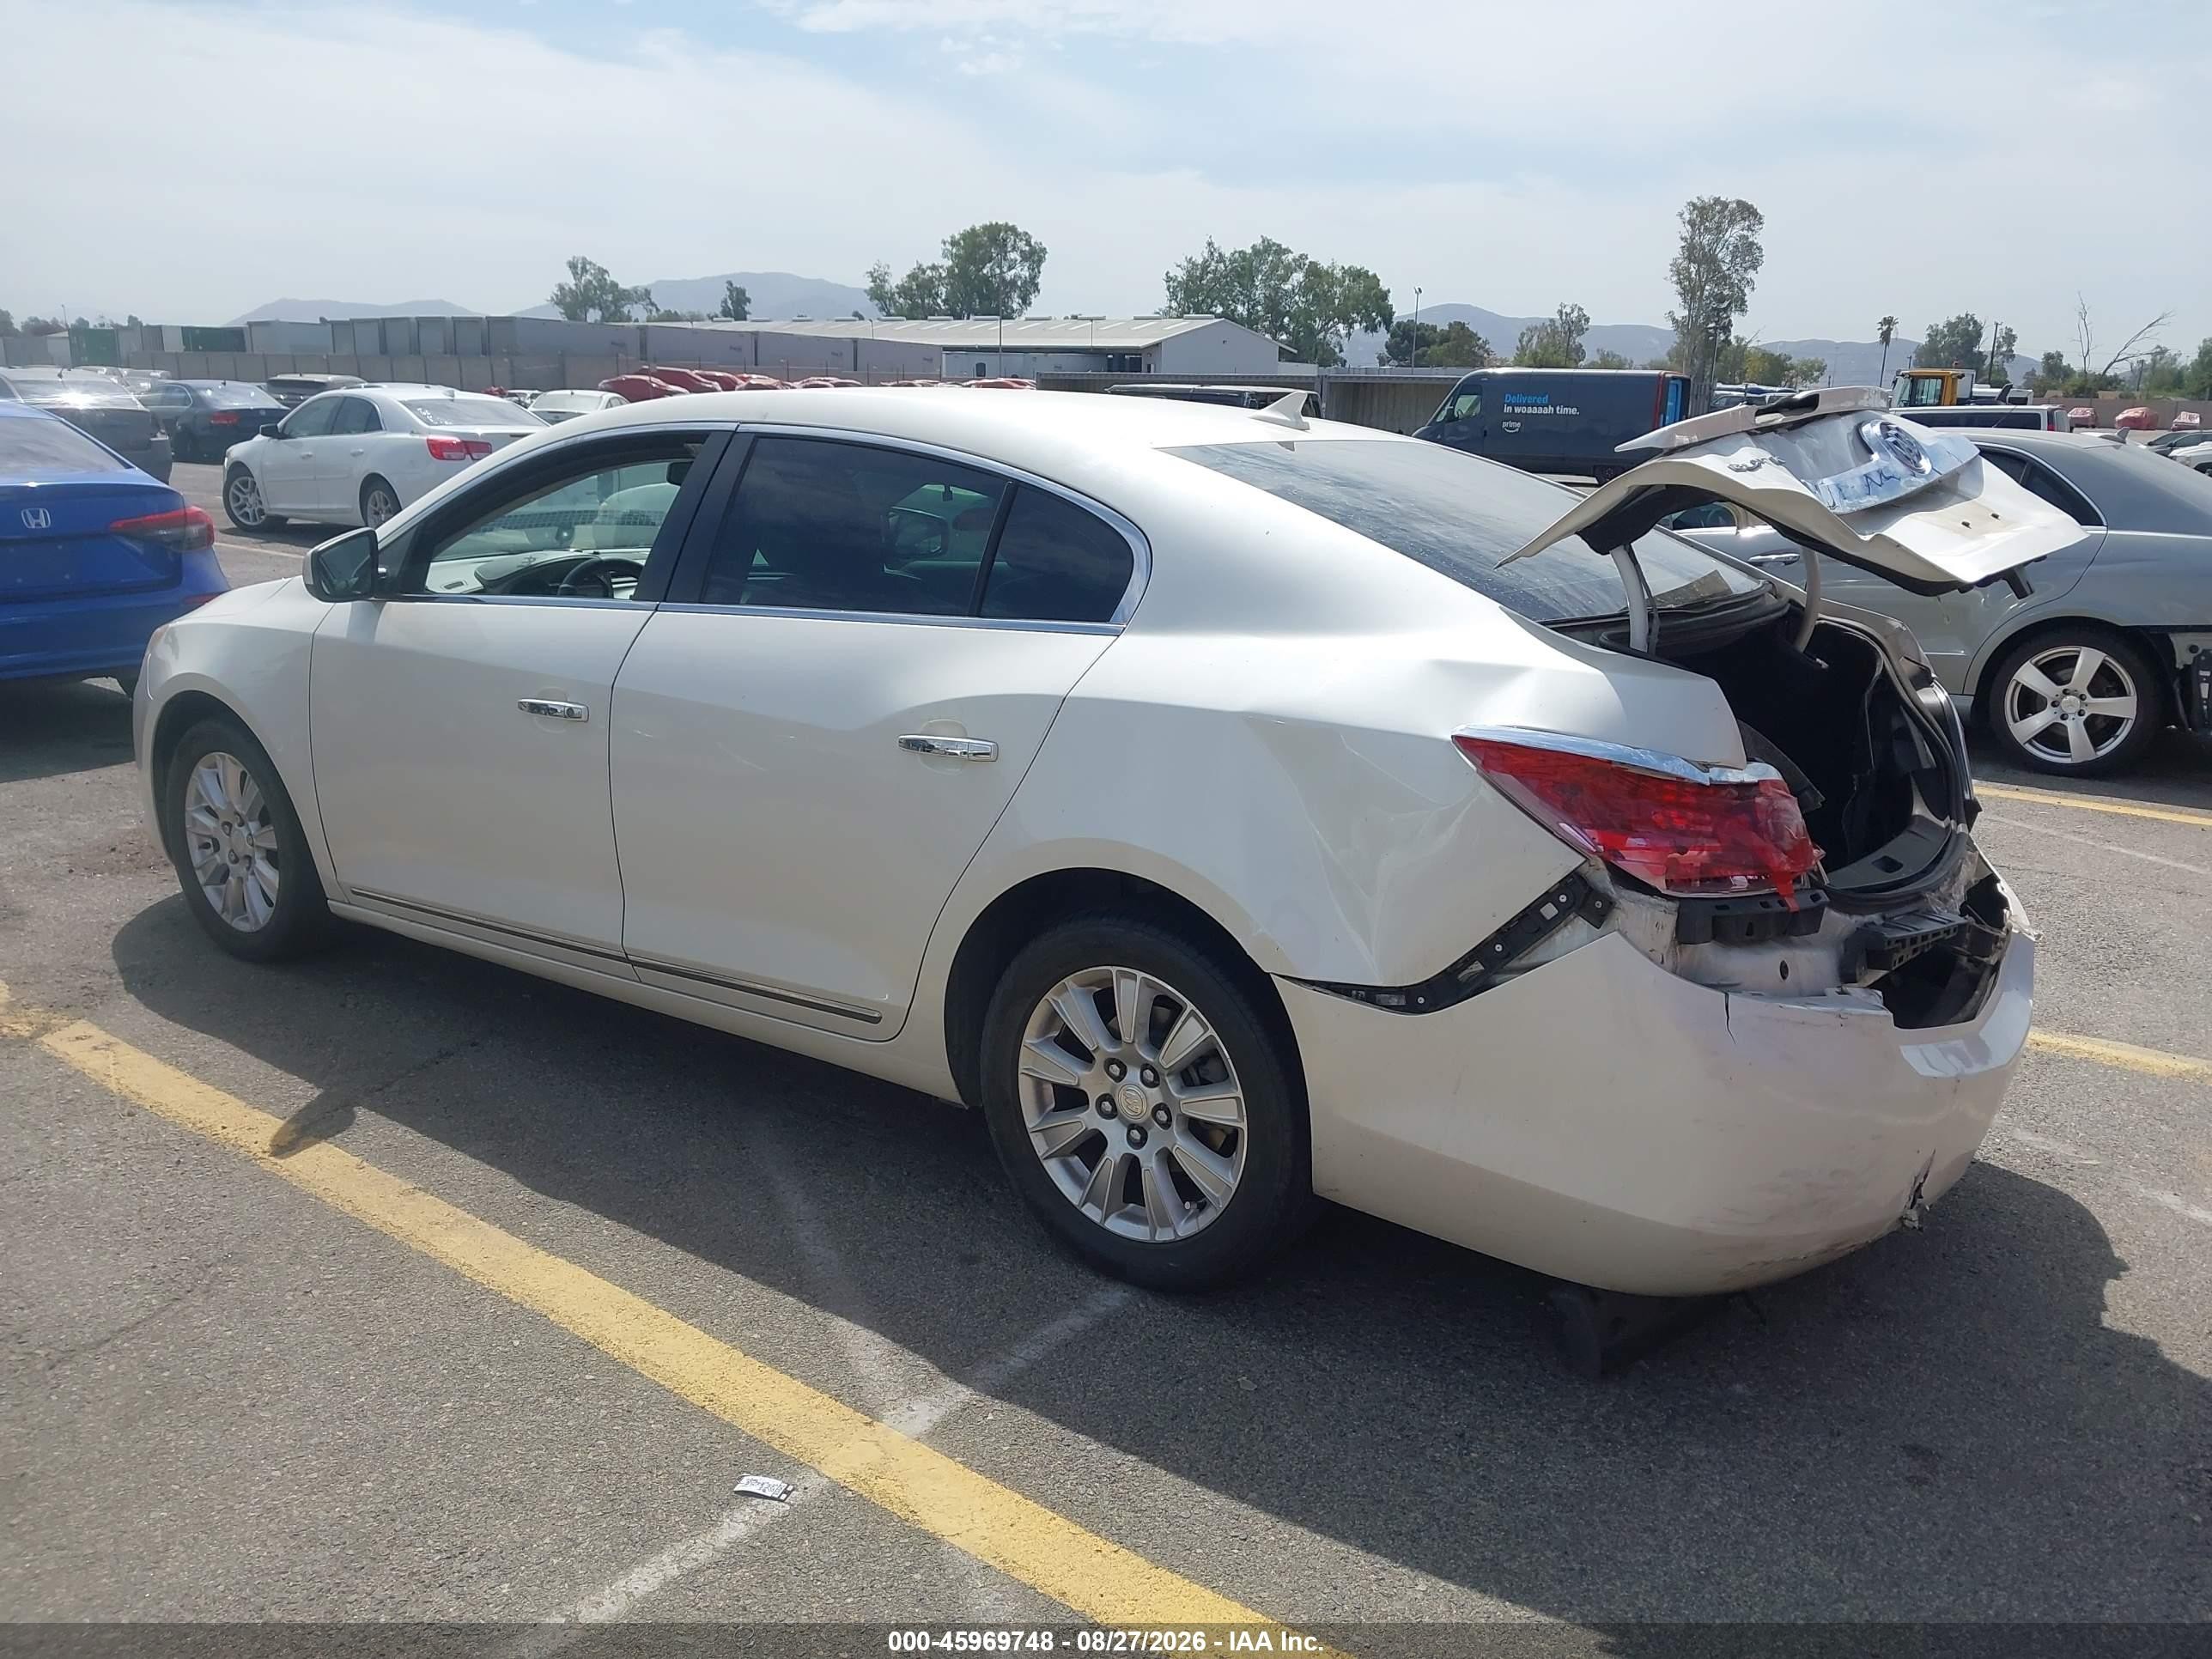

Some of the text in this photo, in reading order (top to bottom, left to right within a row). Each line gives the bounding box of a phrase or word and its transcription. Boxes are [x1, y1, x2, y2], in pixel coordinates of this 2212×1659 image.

[1504, 394, 1548, 404] Delivered
[1504, 404, 1580, 415] in woaaaah time.
